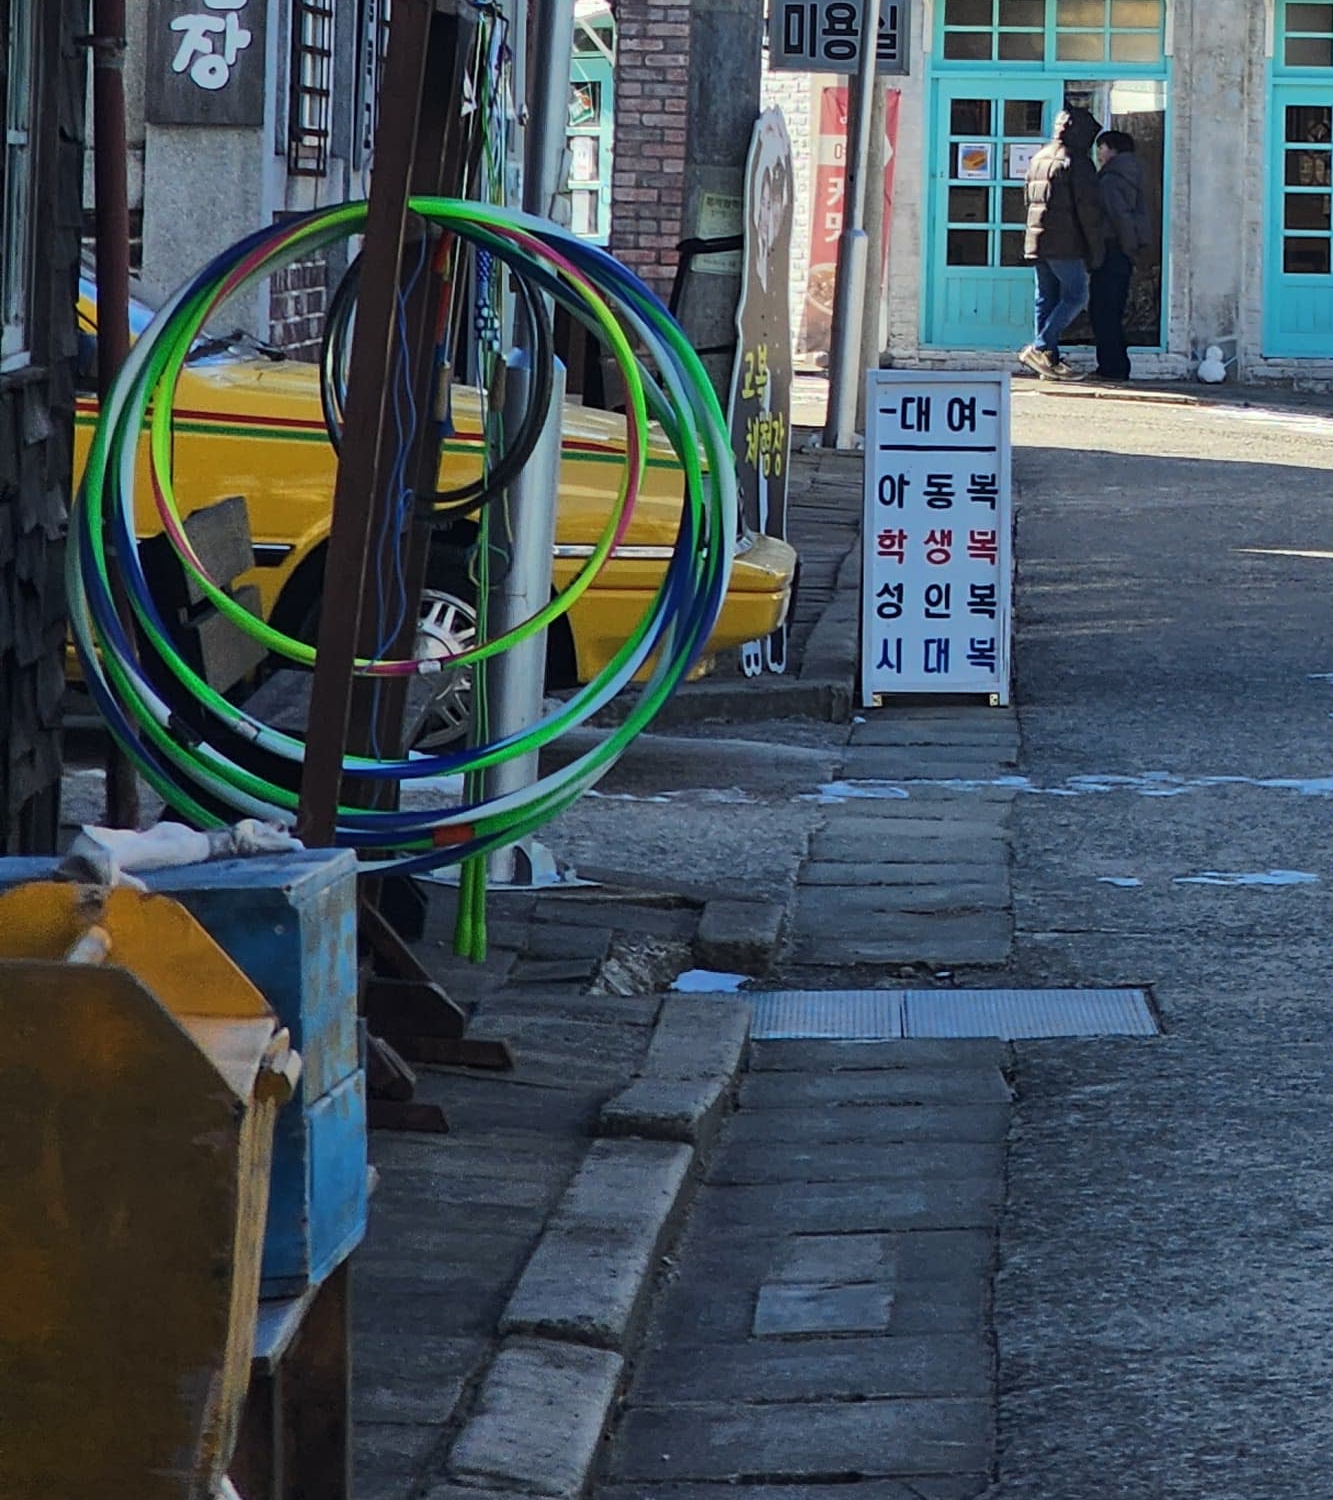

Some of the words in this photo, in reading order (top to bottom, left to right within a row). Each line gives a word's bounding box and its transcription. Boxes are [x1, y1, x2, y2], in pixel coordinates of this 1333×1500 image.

[783, 2, 898, 61] 미용실
[877, 473, 999, 511] 아동복
[876, 528, 998, 565] 학생복
[876, 582, 998, 620] 성인복
[876, 637, 997, 675] 시대복
